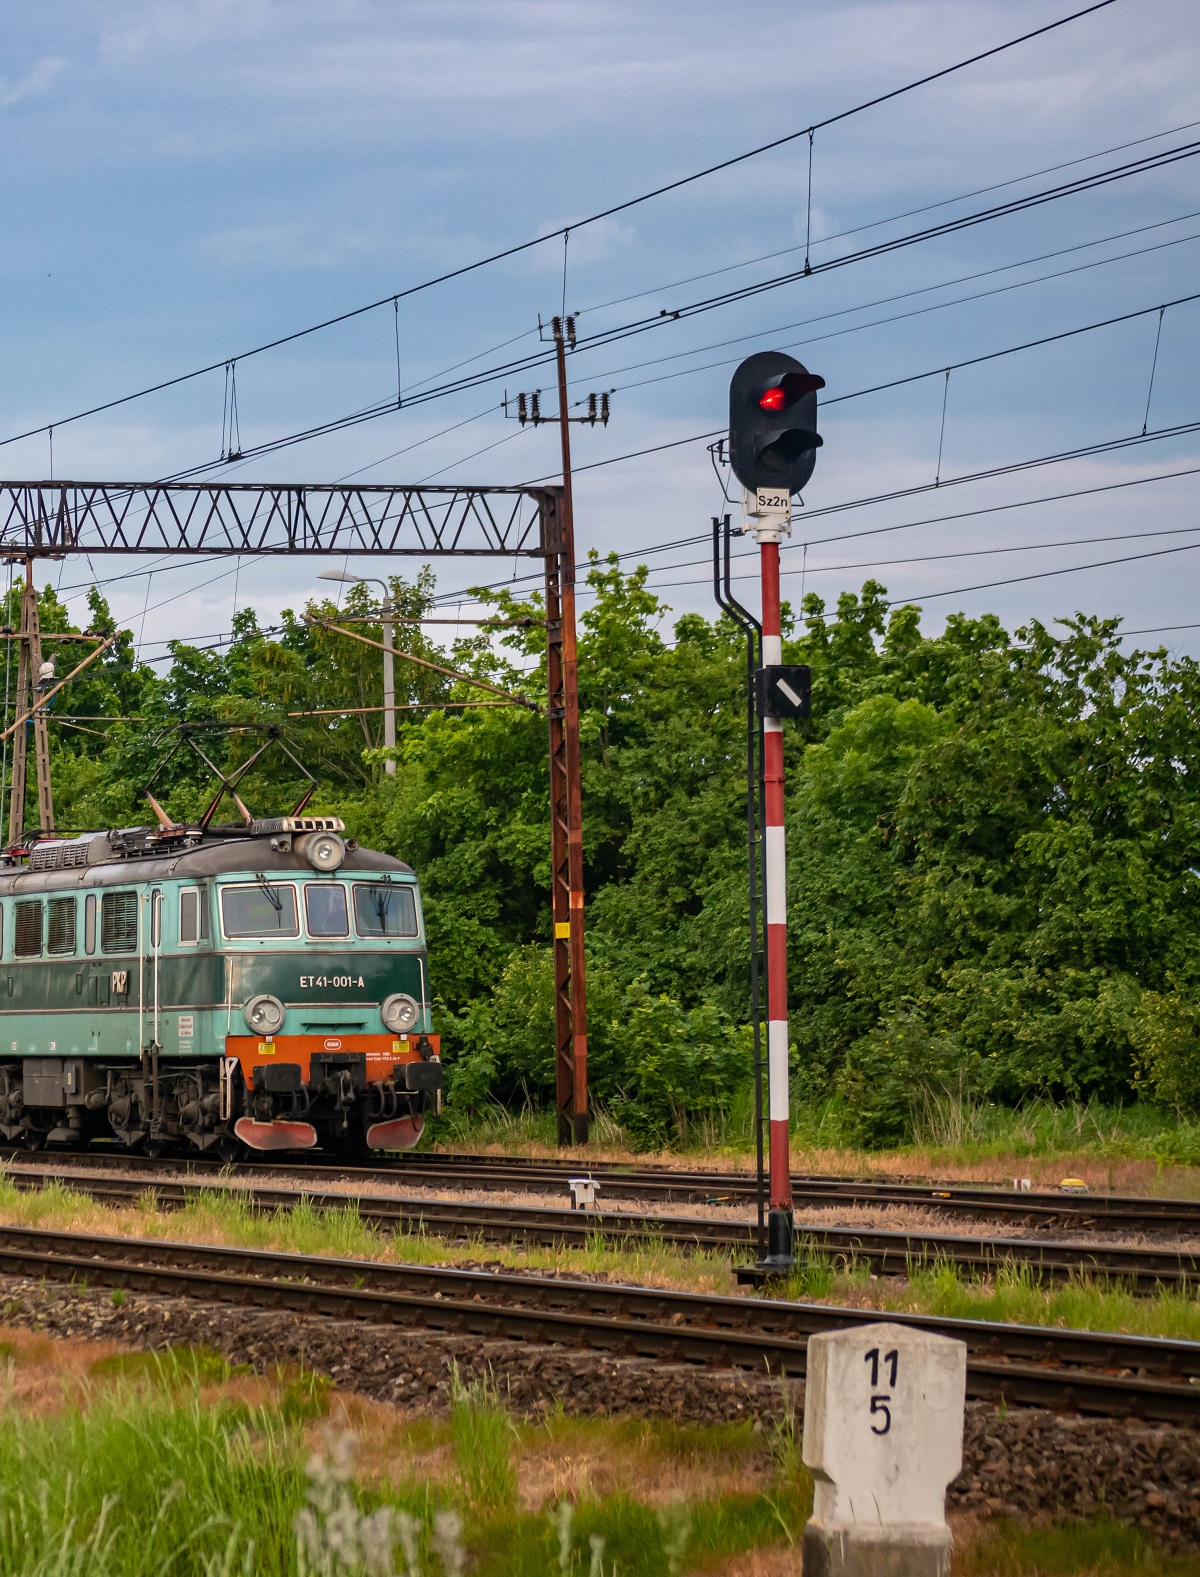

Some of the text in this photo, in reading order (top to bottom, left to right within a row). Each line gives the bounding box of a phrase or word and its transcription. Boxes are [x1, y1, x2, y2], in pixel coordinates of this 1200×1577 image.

[758, 495, 788, 507] Sz2n
[112, 971, 127, 993] PKP
[300, 976, 365, 988] ET41-001-A
[864, 1348, 899, 1388] 11
[870, 1395, 892, 1435] 5
